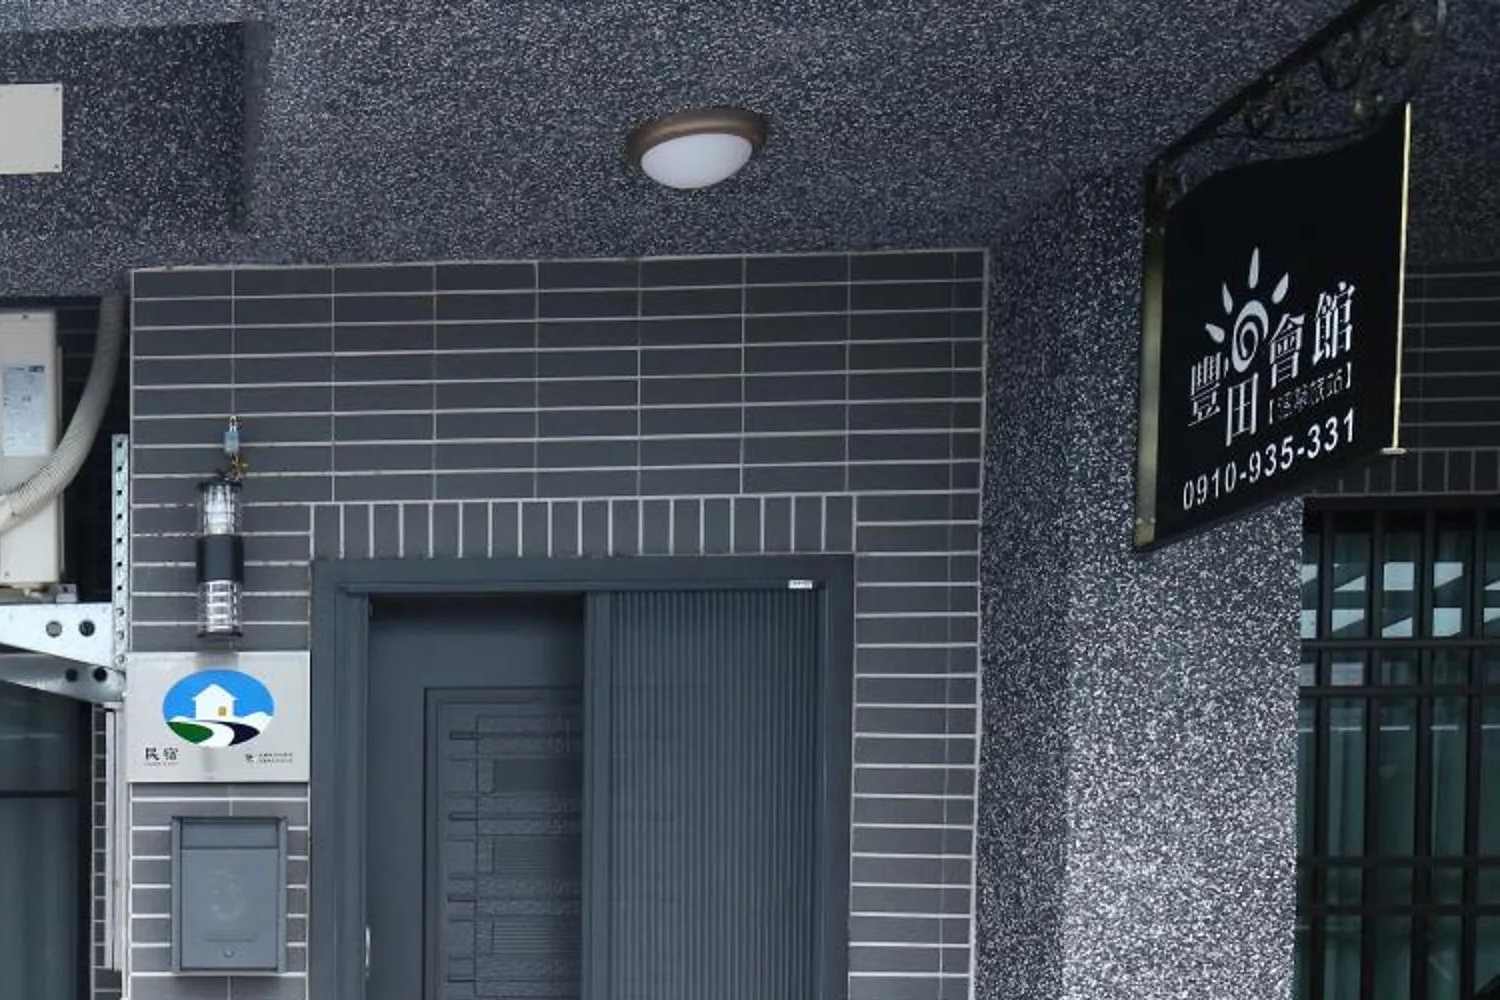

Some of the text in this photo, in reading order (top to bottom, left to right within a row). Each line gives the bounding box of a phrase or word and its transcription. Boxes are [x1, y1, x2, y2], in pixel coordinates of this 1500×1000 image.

[1187, 281, 1355, 447] 豐田會館
[1183, 408, 1354, 510] 0910-935-331
